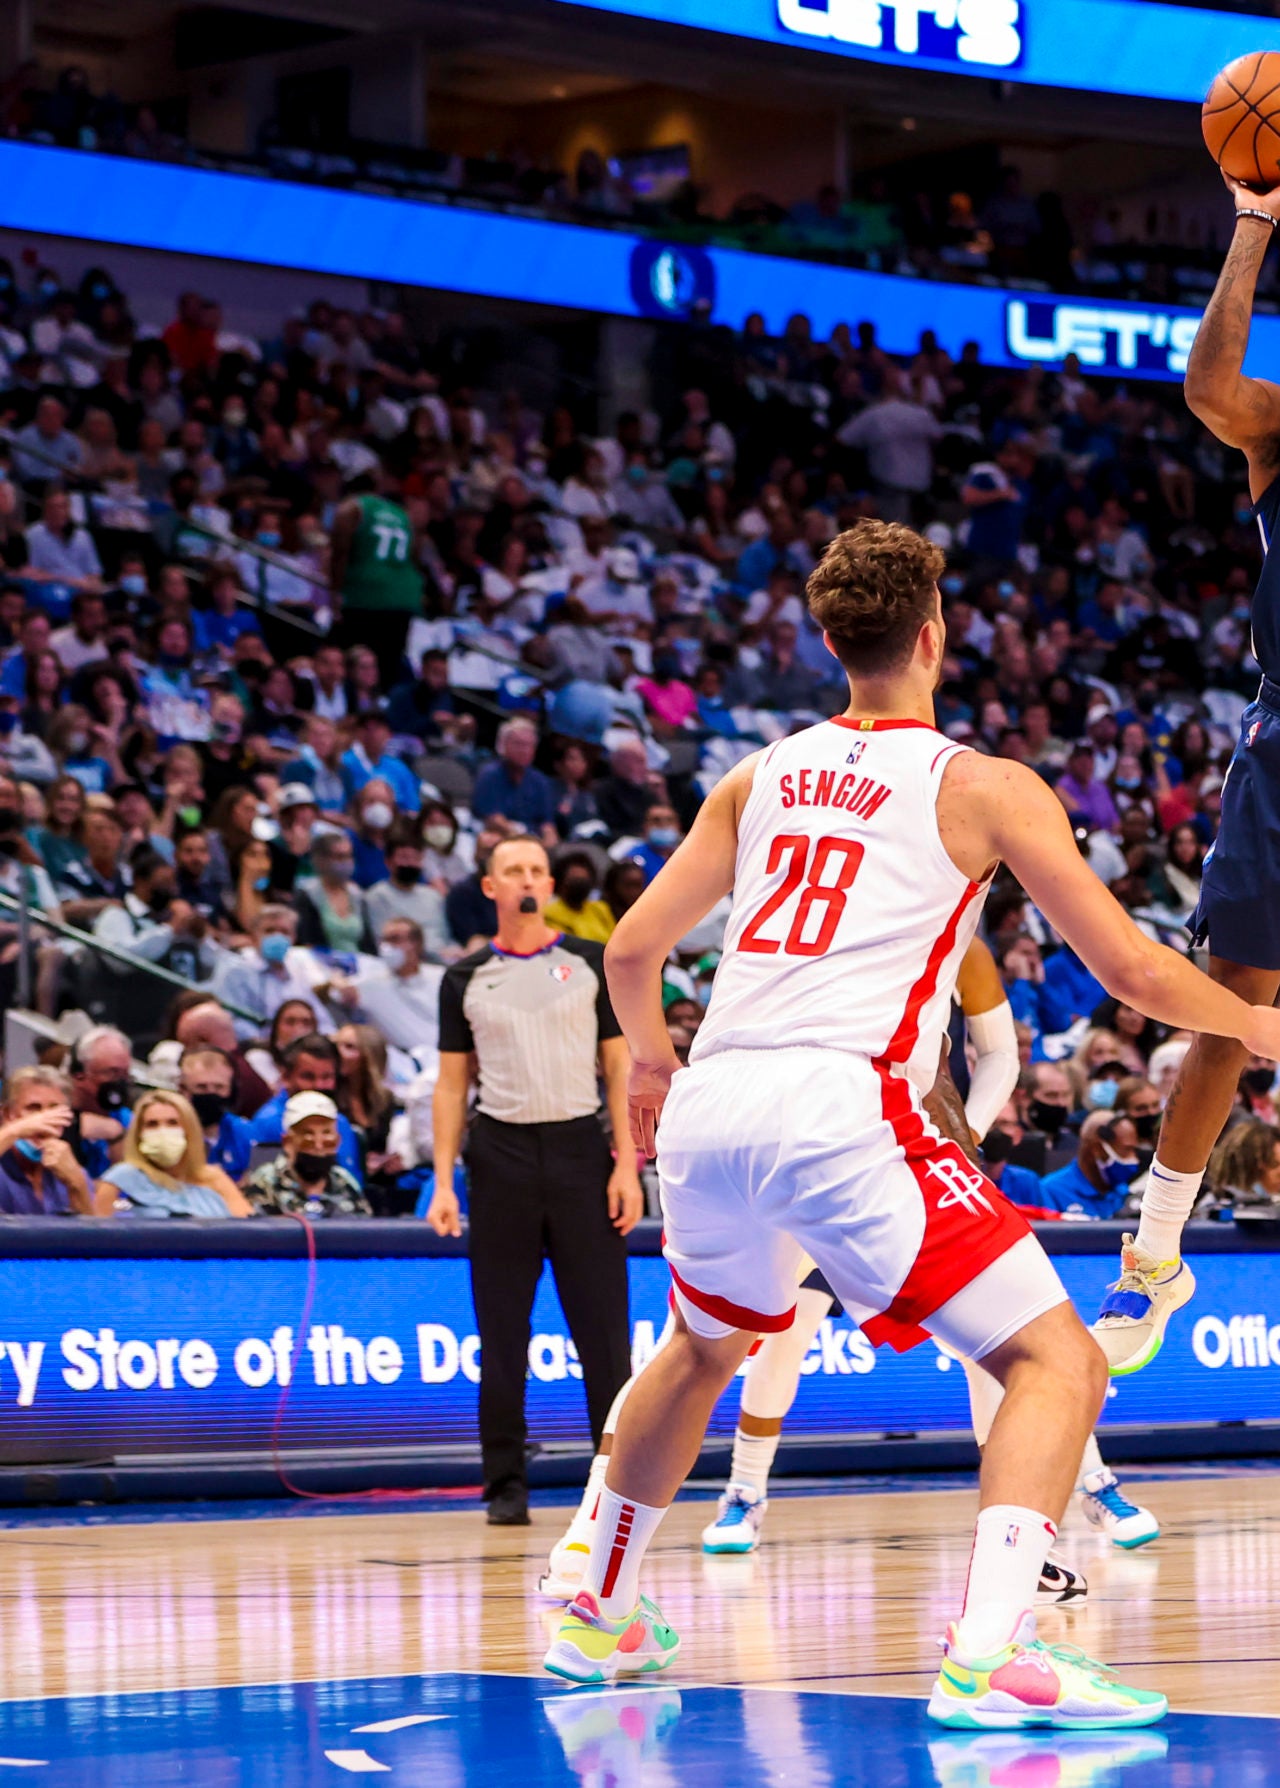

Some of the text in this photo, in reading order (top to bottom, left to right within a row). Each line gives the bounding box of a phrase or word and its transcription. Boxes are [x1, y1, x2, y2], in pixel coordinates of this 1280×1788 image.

[778, 0, 1021, 65] LET'S
[1007, 300, 1202, 373] LET'S
[372, 525, 408, 560] 77
[779, 769, 892, 821] SENGUN
[736, 834, 865, 956] 28
[60, 1328, 218, 1390] Store
[234, 1326, 293, 1388] of
[308, 1325, 404, 1386] the
